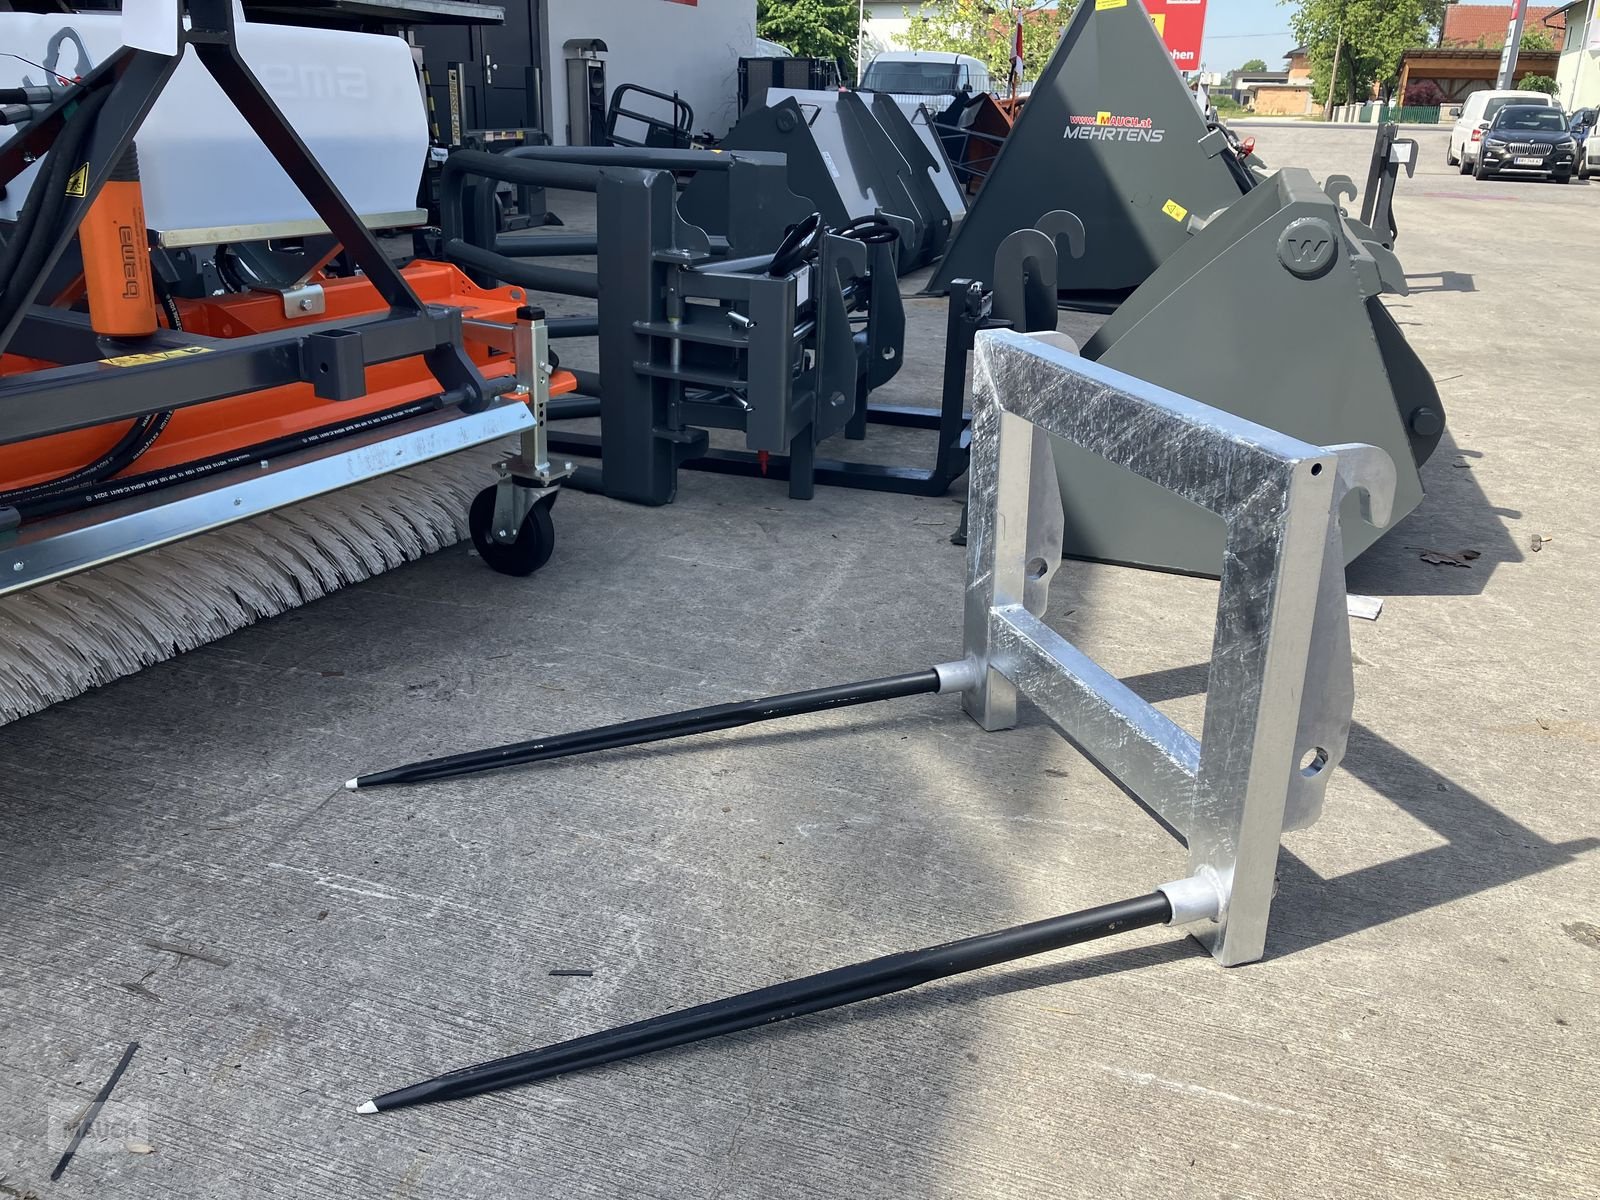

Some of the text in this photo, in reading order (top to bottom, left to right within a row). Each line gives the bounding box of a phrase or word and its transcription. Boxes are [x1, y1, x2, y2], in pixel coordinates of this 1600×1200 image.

[1169, 49, 1194, 60] hen
[1063, 126, 1165, 142] MEHRTENS
[1287, 239, 1328, 262] W
[119, 225, 140, 299] bema
